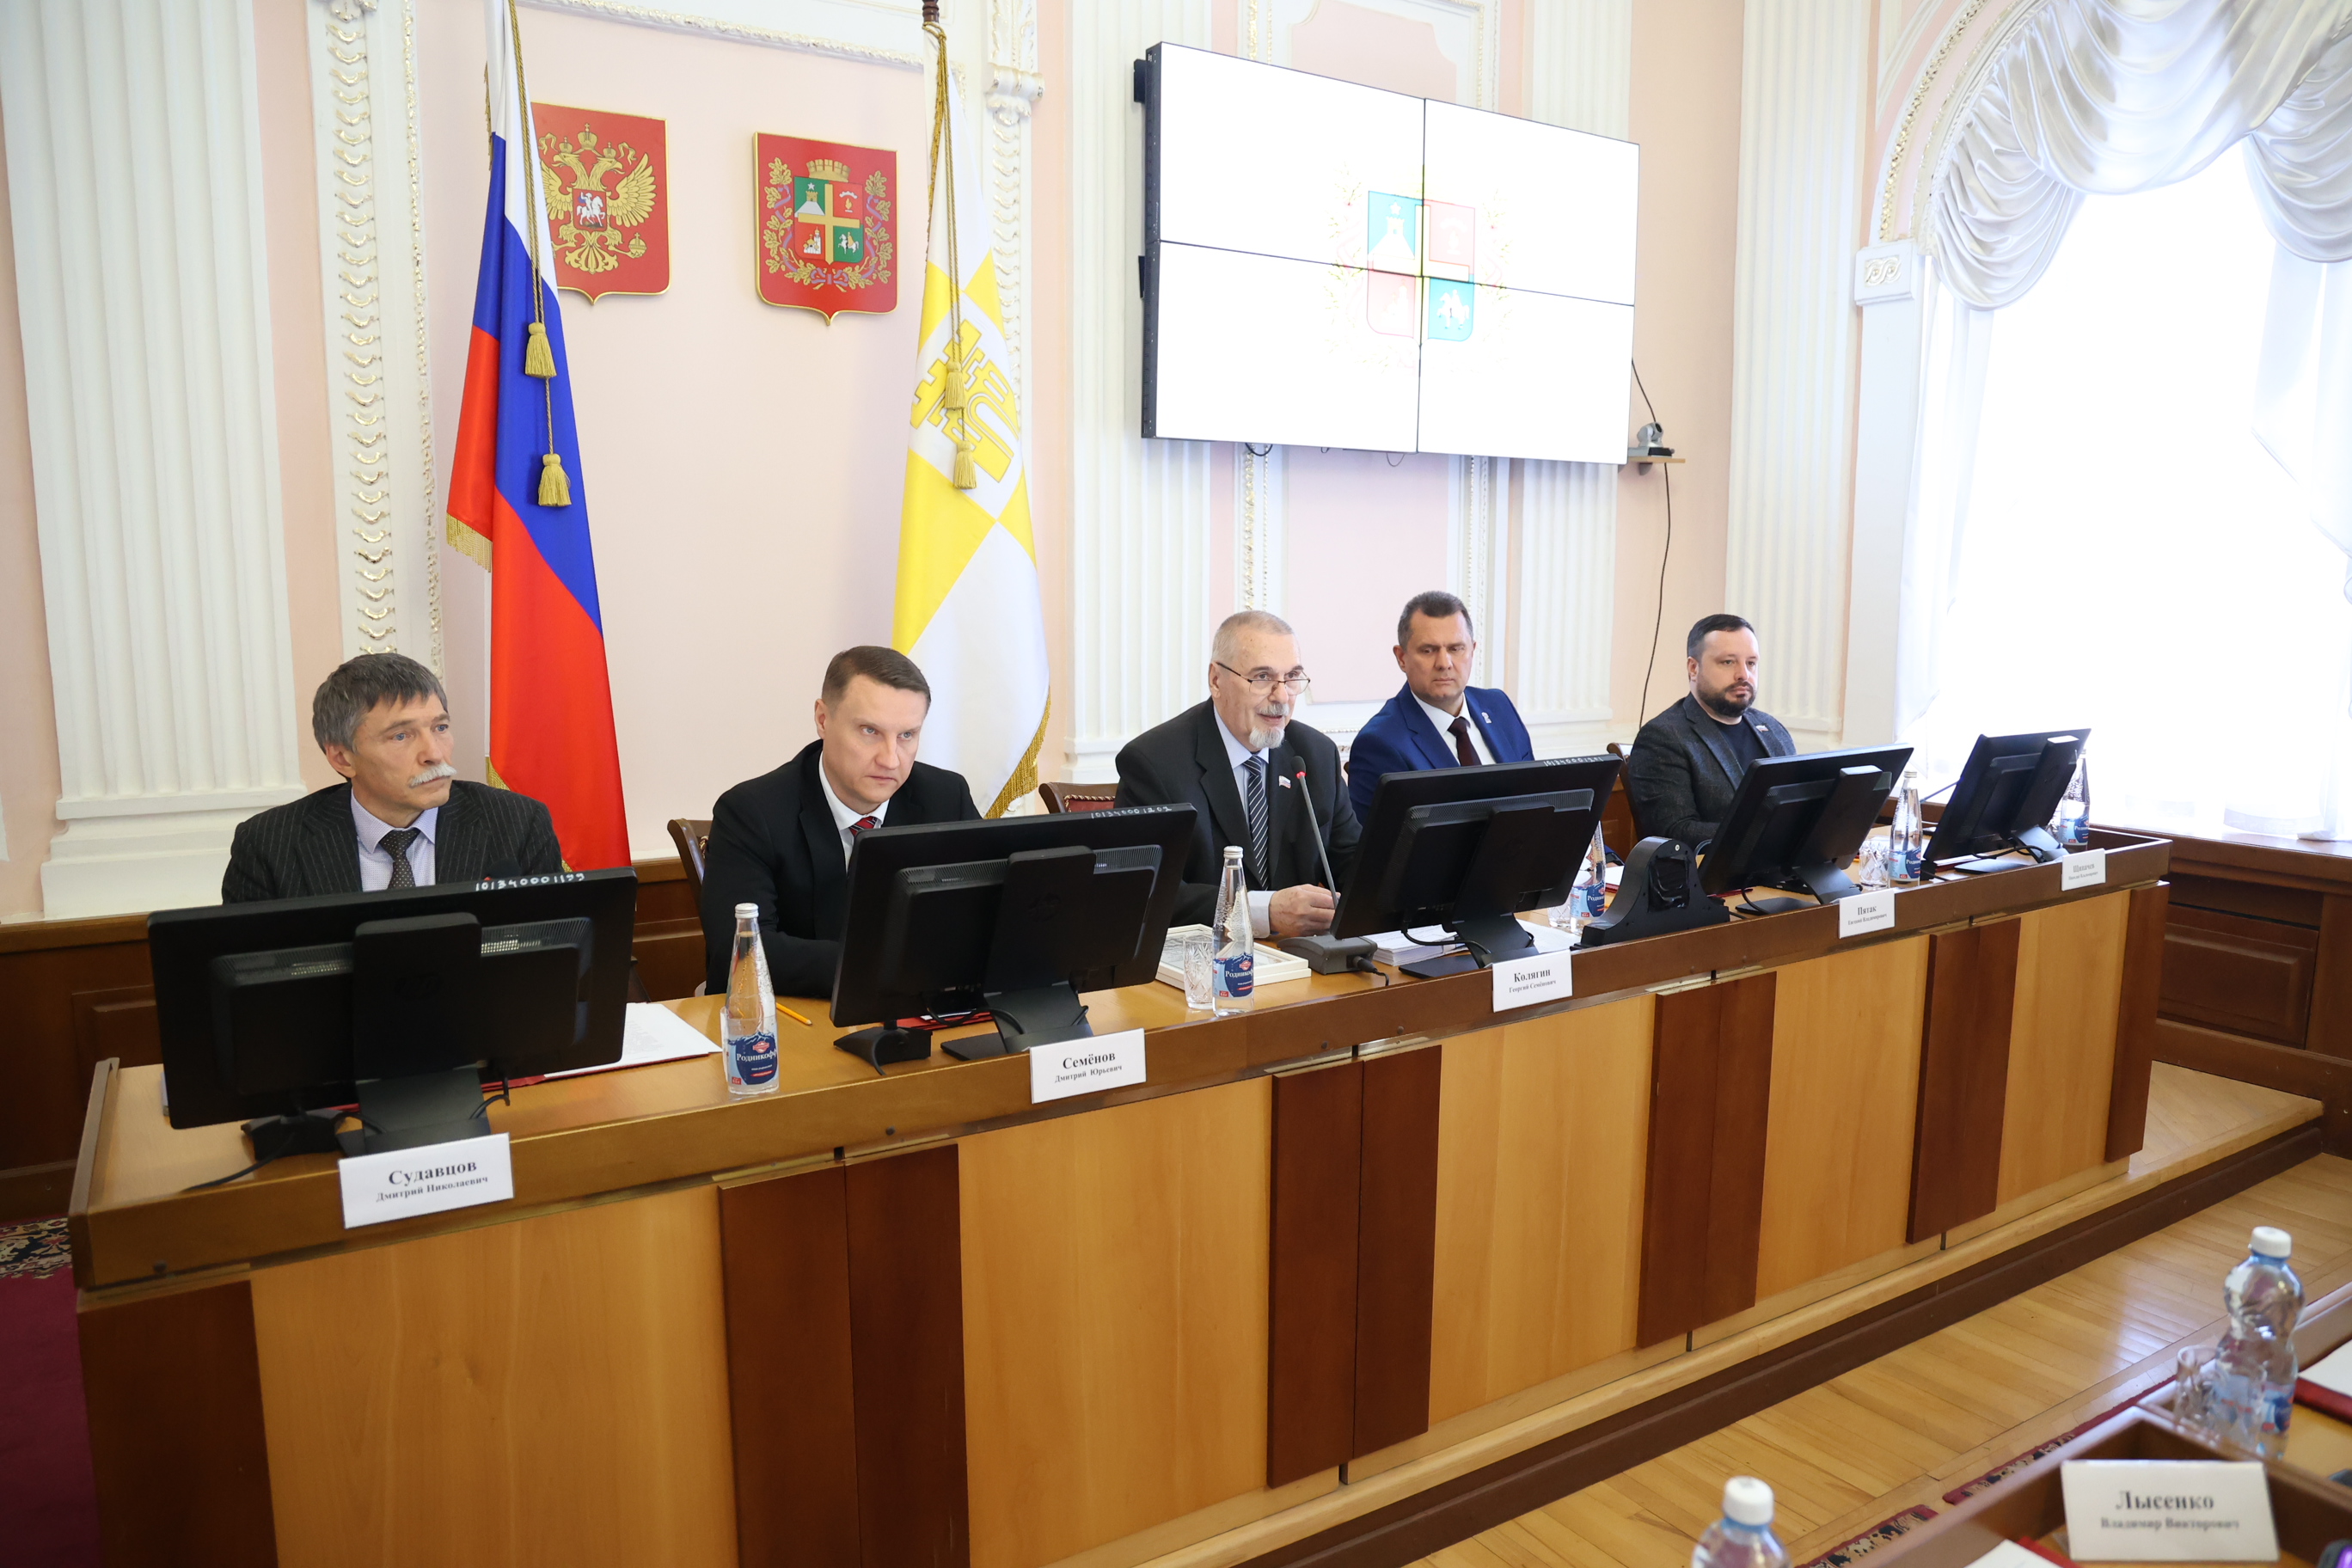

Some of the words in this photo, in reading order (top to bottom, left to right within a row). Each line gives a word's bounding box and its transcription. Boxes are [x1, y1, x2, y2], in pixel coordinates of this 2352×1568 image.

[1858, 906, 1877, 916] Пятак
[1514, 969, 1551, 983] Колягин
[1063, 1052, 1116, 1069] Семёнов
[1055, 1071, 1087, 1083] Дмитрий
[1090, 1065, 1123, 1076] Юрьевич
[389, 1161, 477, 1186] Судавцов
[376, 1186, 424, 1203] Дмитрий
[426, 1176, 488, 1193] Николаевич
[2116, 1491, 2214, 1510] Лысенко
